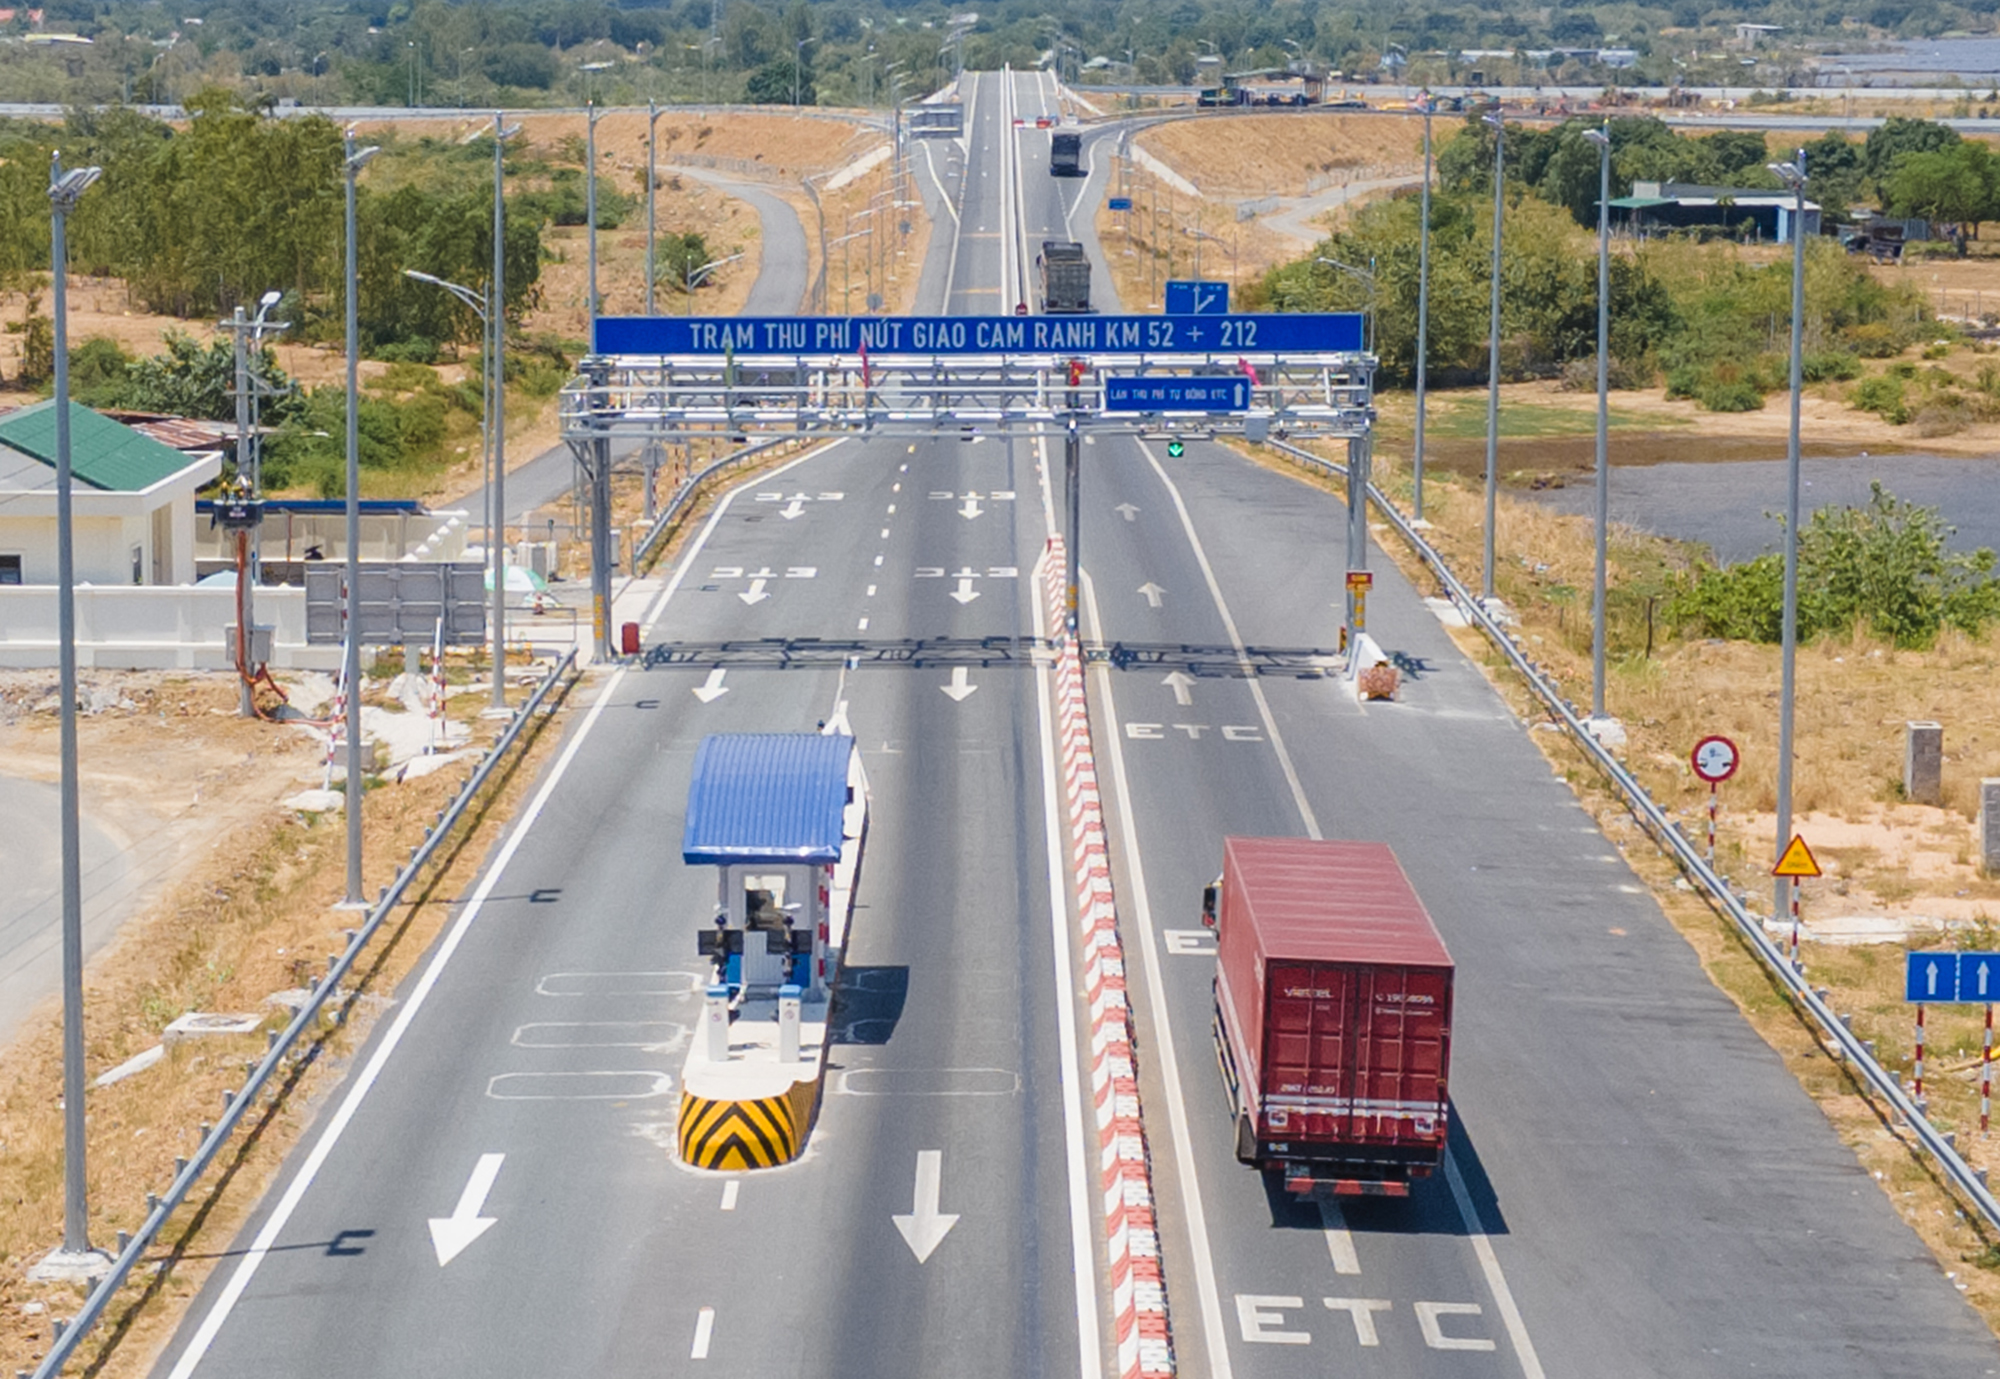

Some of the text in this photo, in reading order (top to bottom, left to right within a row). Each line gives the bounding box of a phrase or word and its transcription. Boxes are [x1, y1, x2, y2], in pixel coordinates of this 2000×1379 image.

[764, 323, 806, 349] THU
[816, 317, 852, 349] PHÍ
[859, 318, 902, 349] NÚT
[912, 322, 966, 349] GIAO
[976, 322, 1025, 349] CAM
[1034, 322, 1096, 349] RANH
[1106, 322, 1140, 348] KM
[1148, 321, 1174, 348] 52
[1186, 325, 1204, 343] +
[1220, 320, 1257, 347] 212
[1125, 723, 1264, 741] ETC
[1234, 1294, 1496, 1350] ETC
